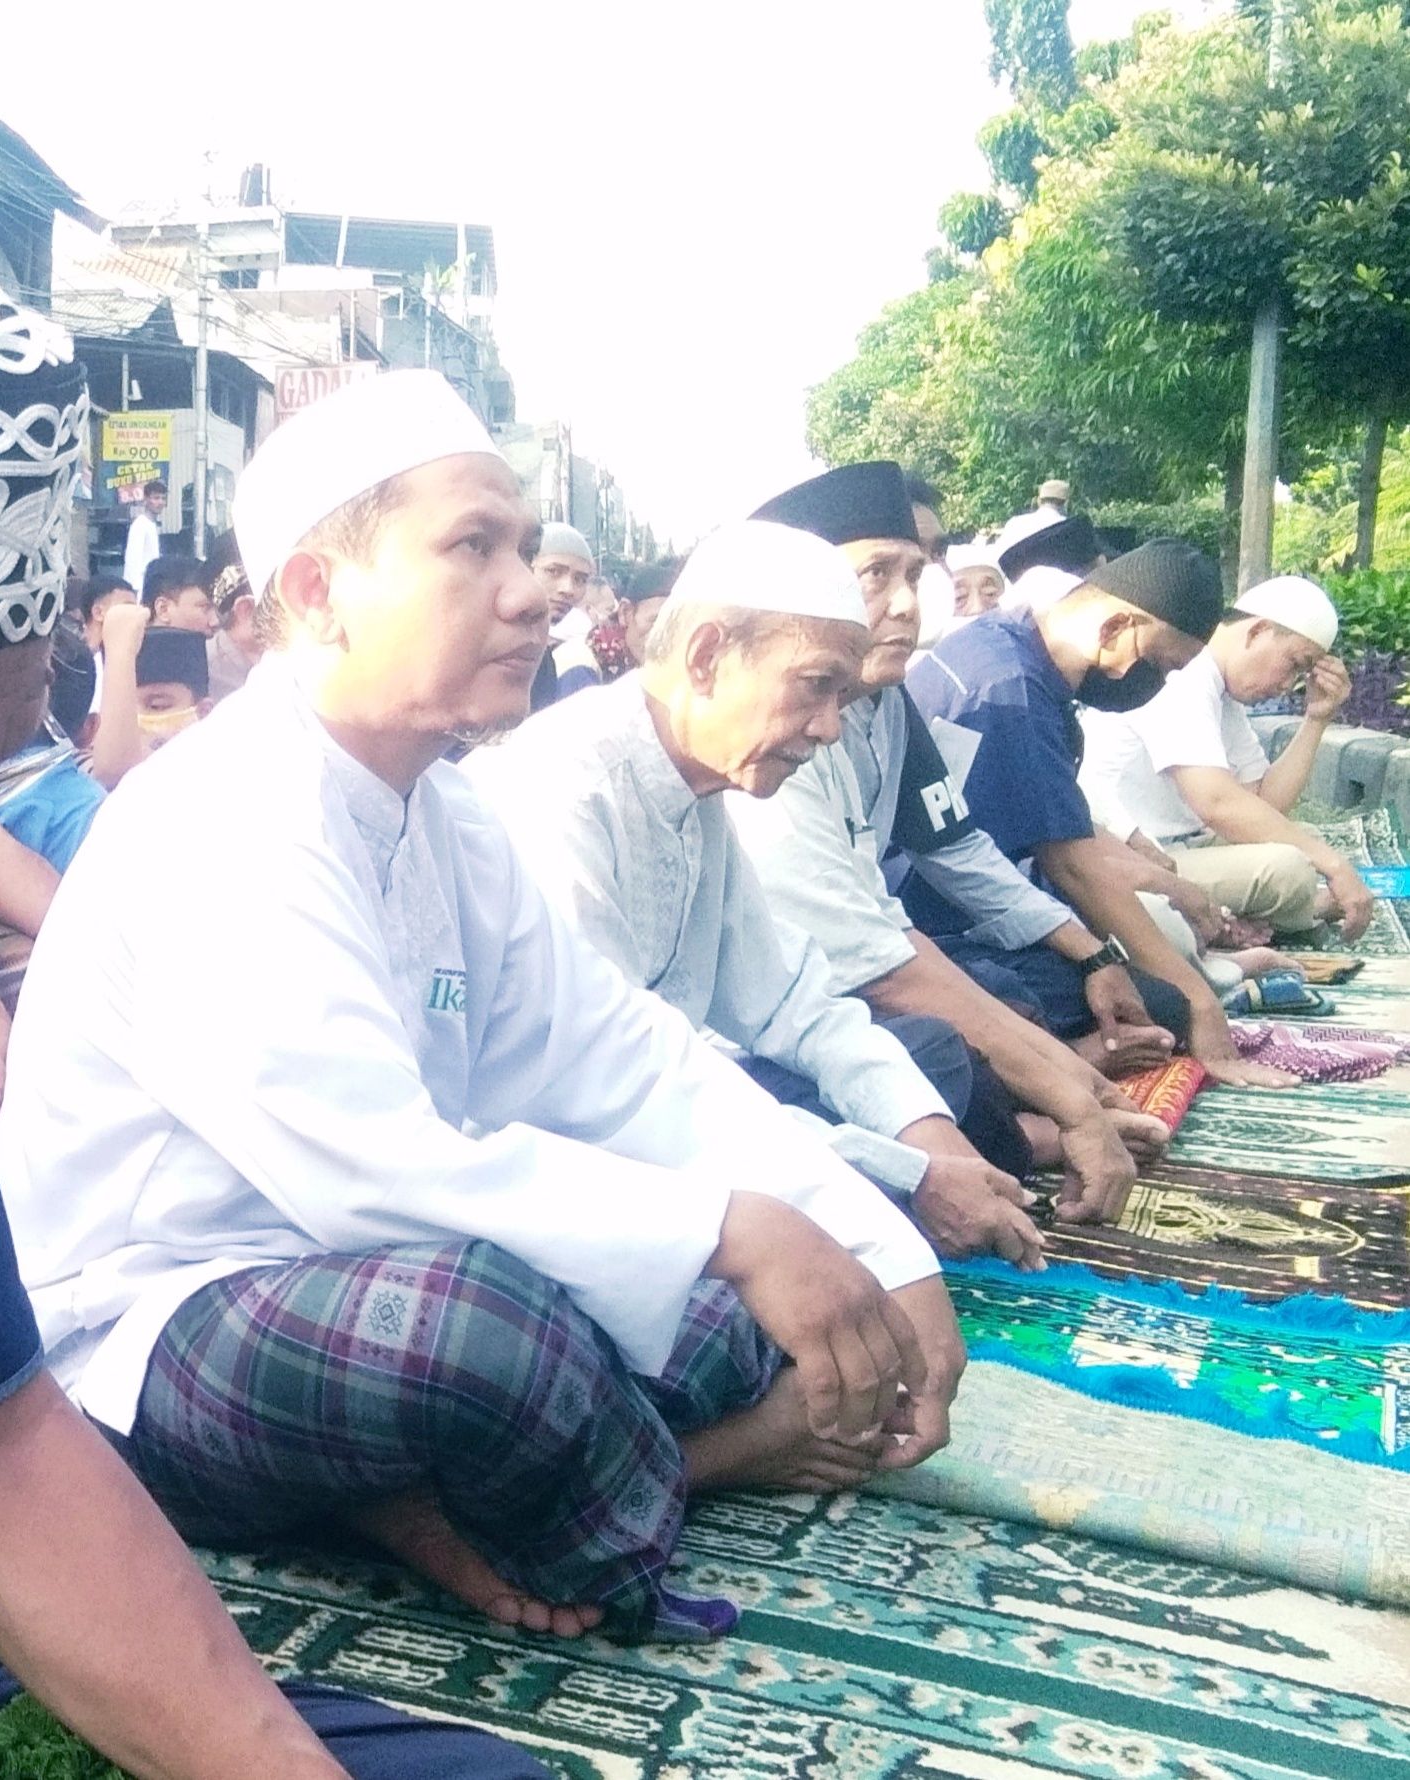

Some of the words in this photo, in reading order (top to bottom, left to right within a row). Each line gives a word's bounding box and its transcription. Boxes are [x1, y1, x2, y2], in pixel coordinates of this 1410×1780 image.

[116, 431, 159, 439] MURAH
[129, 446, 159, 460] 900
[117, 462, 153, 476] CETAK
